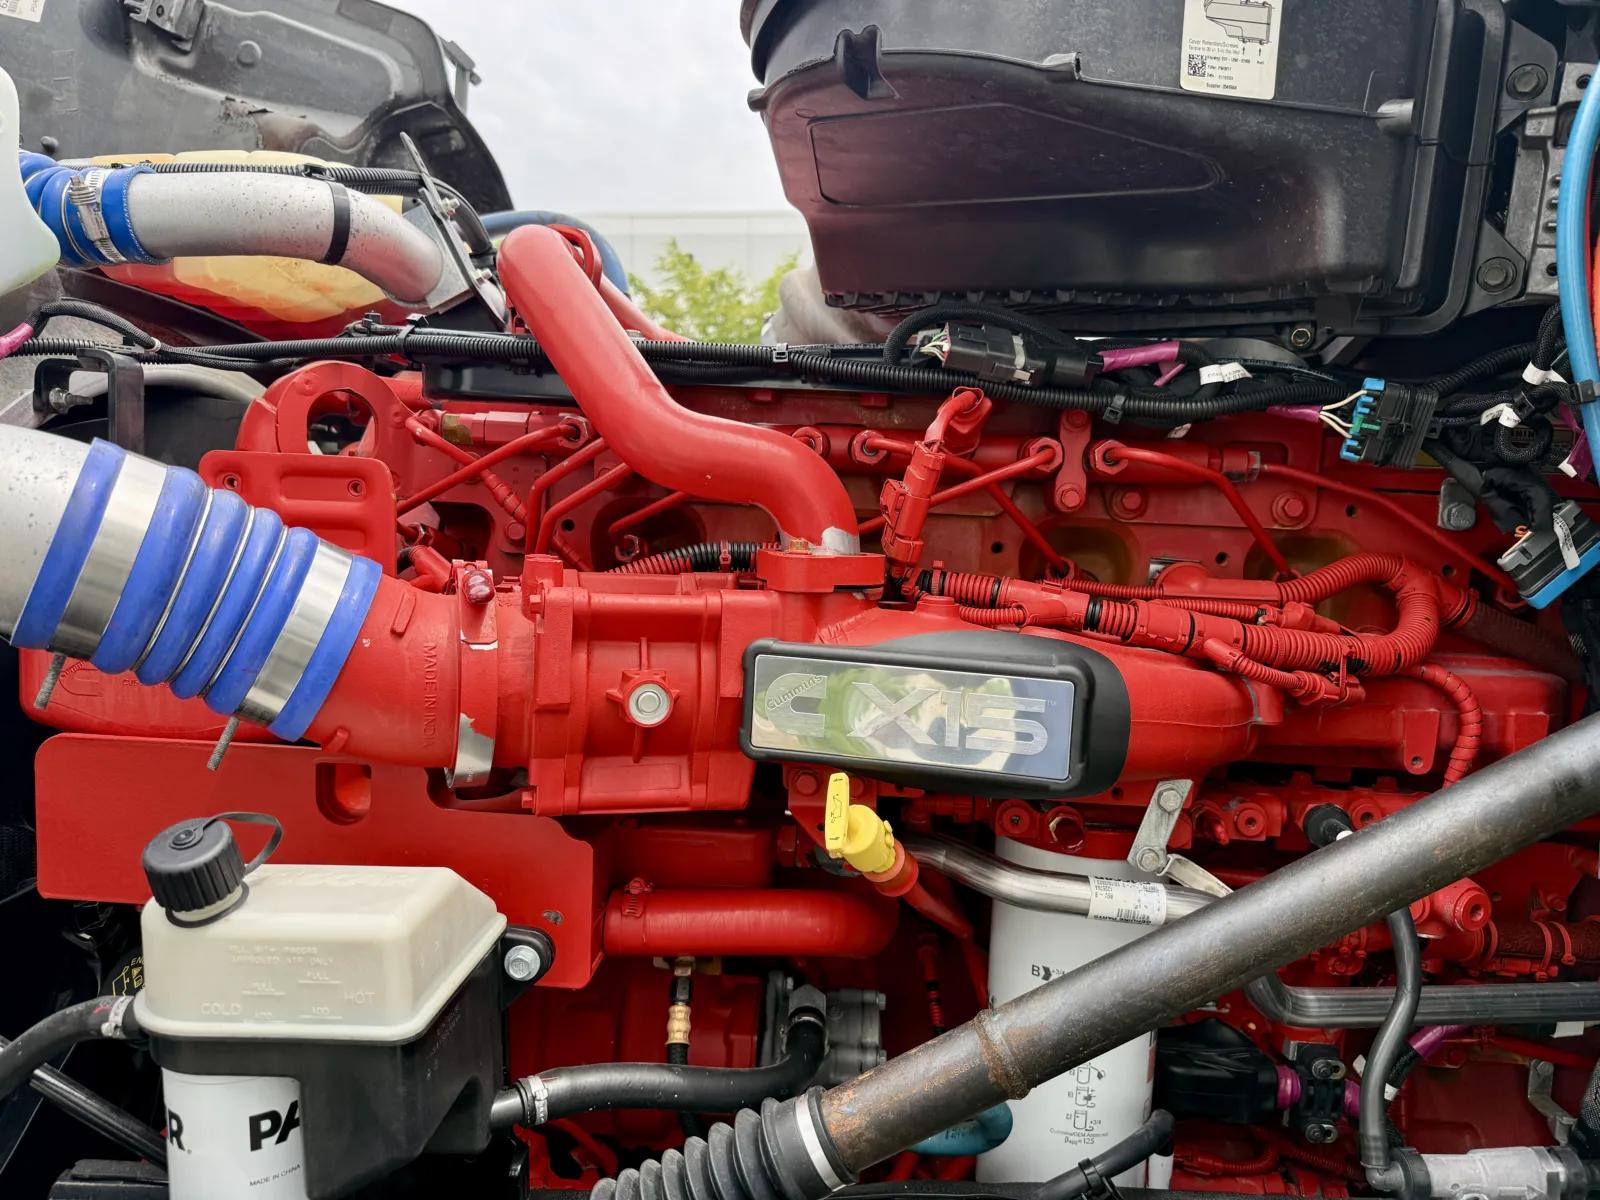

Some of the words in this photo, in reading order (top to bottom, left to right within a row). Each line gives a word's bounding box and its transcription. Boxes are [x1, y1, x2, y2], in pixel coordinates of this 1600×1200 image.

[423, 642, 437, 691] MADE
[424, 694, 437, 710] IN
[1031, 964, 1041, 977] B
[344, 991, 376, 1004] HOT
[200, 1002, 241, 1016] COLD
[249, 1176, 270, 1187] MADE
[272, 1172, 280, 1181] IN
[280, 1163, 300, 1178] CHINA
